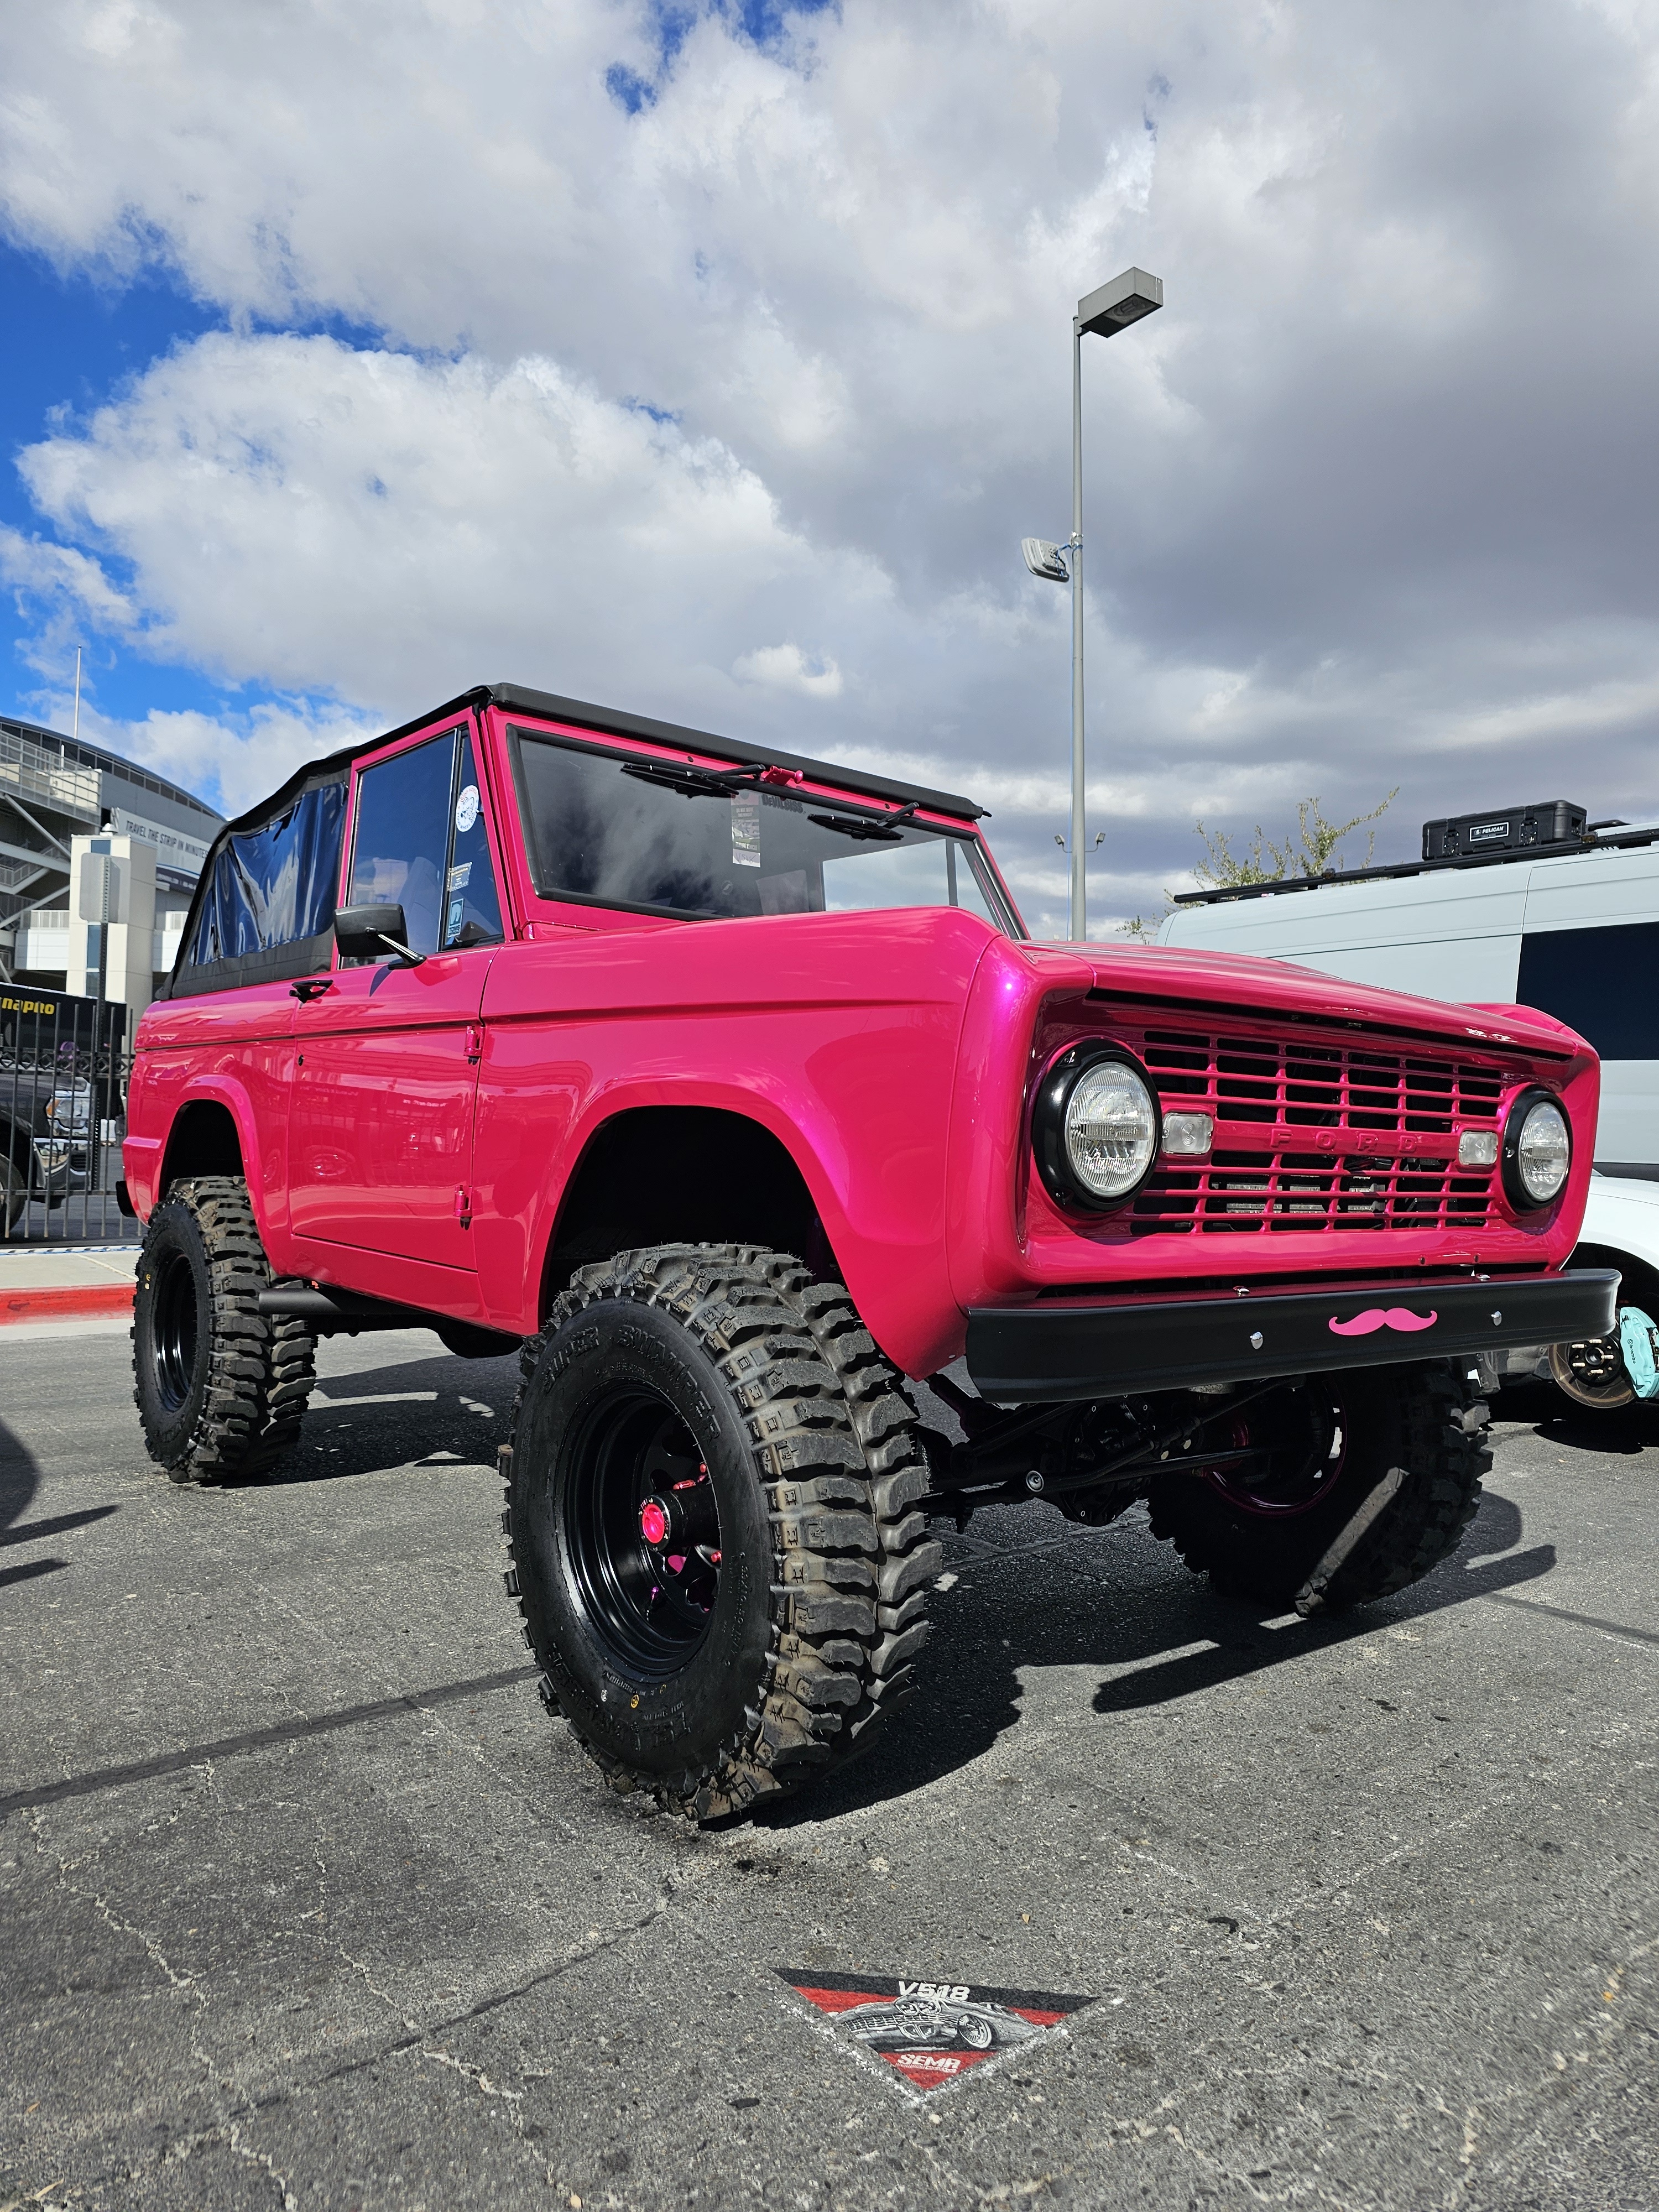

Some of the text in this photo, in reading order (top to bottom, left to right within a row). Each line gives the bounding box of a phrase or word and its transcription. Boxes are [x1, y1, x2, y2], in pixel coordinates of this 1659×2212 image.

[126, 820, 146, 837] TRAVEL
[148, 828, 159, 842] THE
[160, 833, 177, 847] STRIP
[178, 839, 184, 851] IN
[1270, 1128, 1417, 1152] FORD
[899, 1981, 971, 2001] V518
[897, 2054, 962, 2069] SEMA
